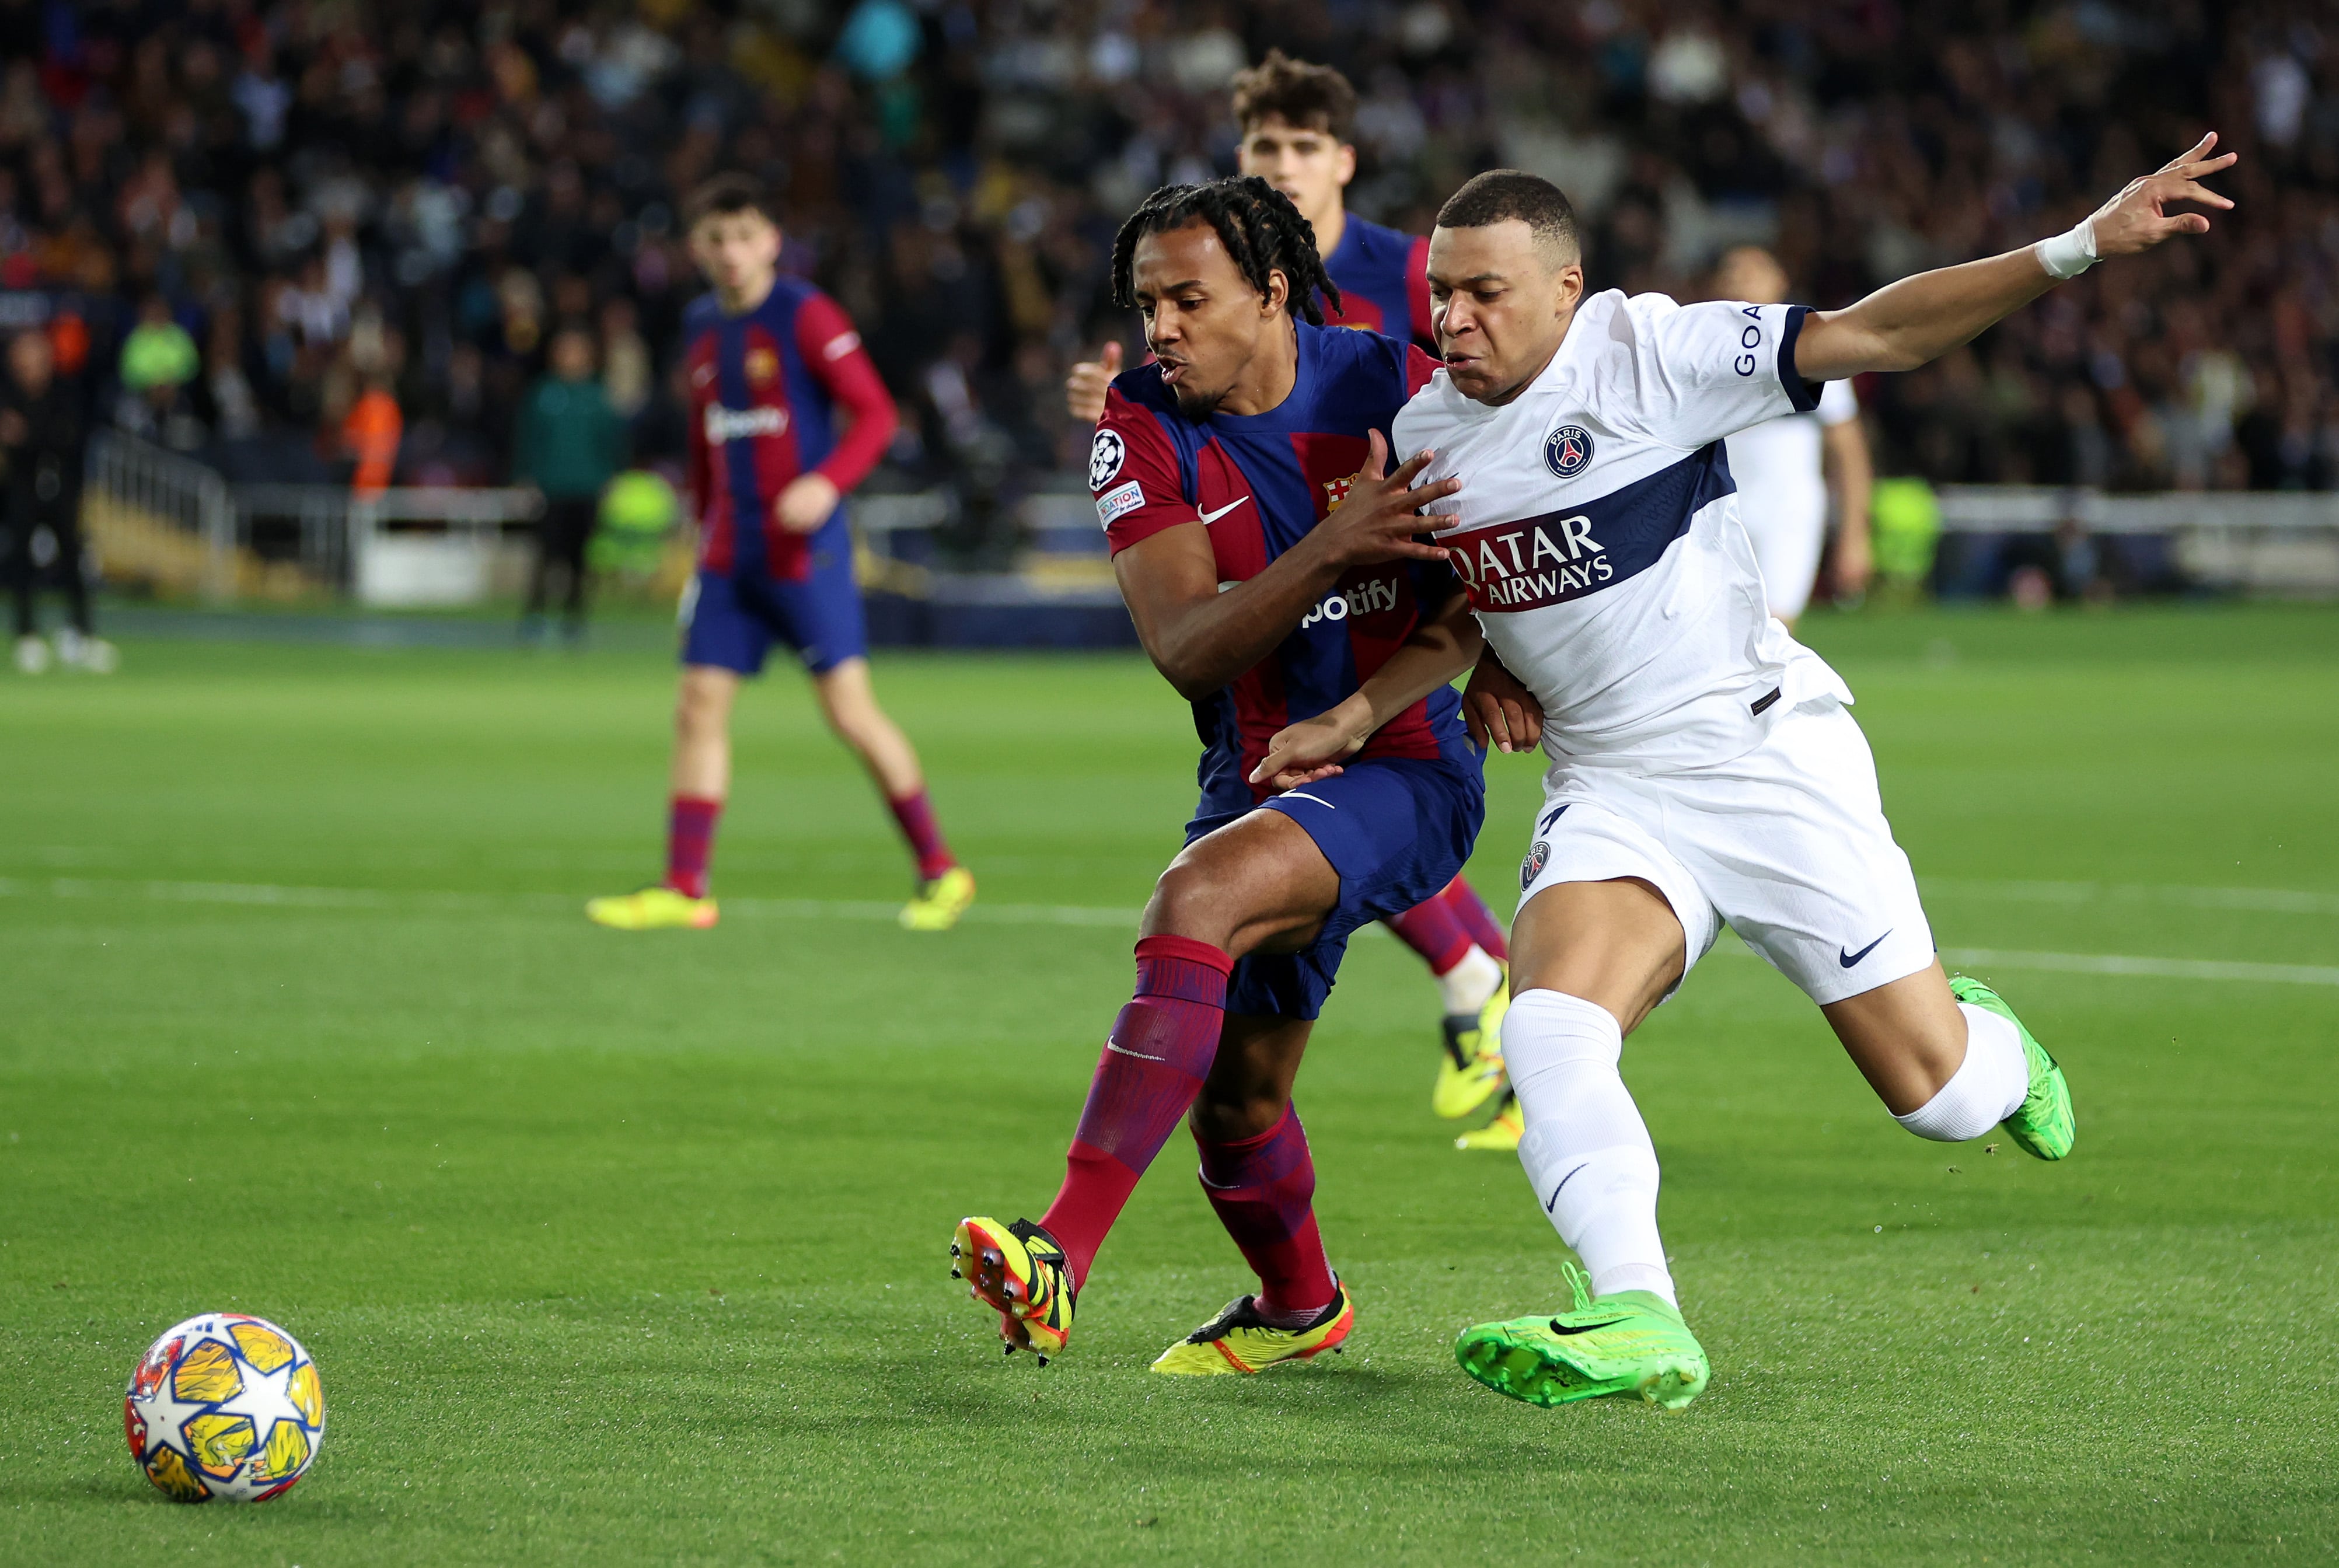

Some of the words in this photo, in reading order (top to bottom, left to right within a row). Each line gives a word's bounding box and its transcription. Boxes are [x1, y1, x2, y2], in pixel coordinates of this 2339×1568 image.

[1734, 305, 1766, 376] GOA
[1551, 429, 1582, 445] PARIS
[1448, 515, 1605, 592] QATAR
[1302, 578, 1397, 628] potify
[1488, 555, 1613, 605] AIRWAYS
[1524, 845, 1543, 867] PARIS
